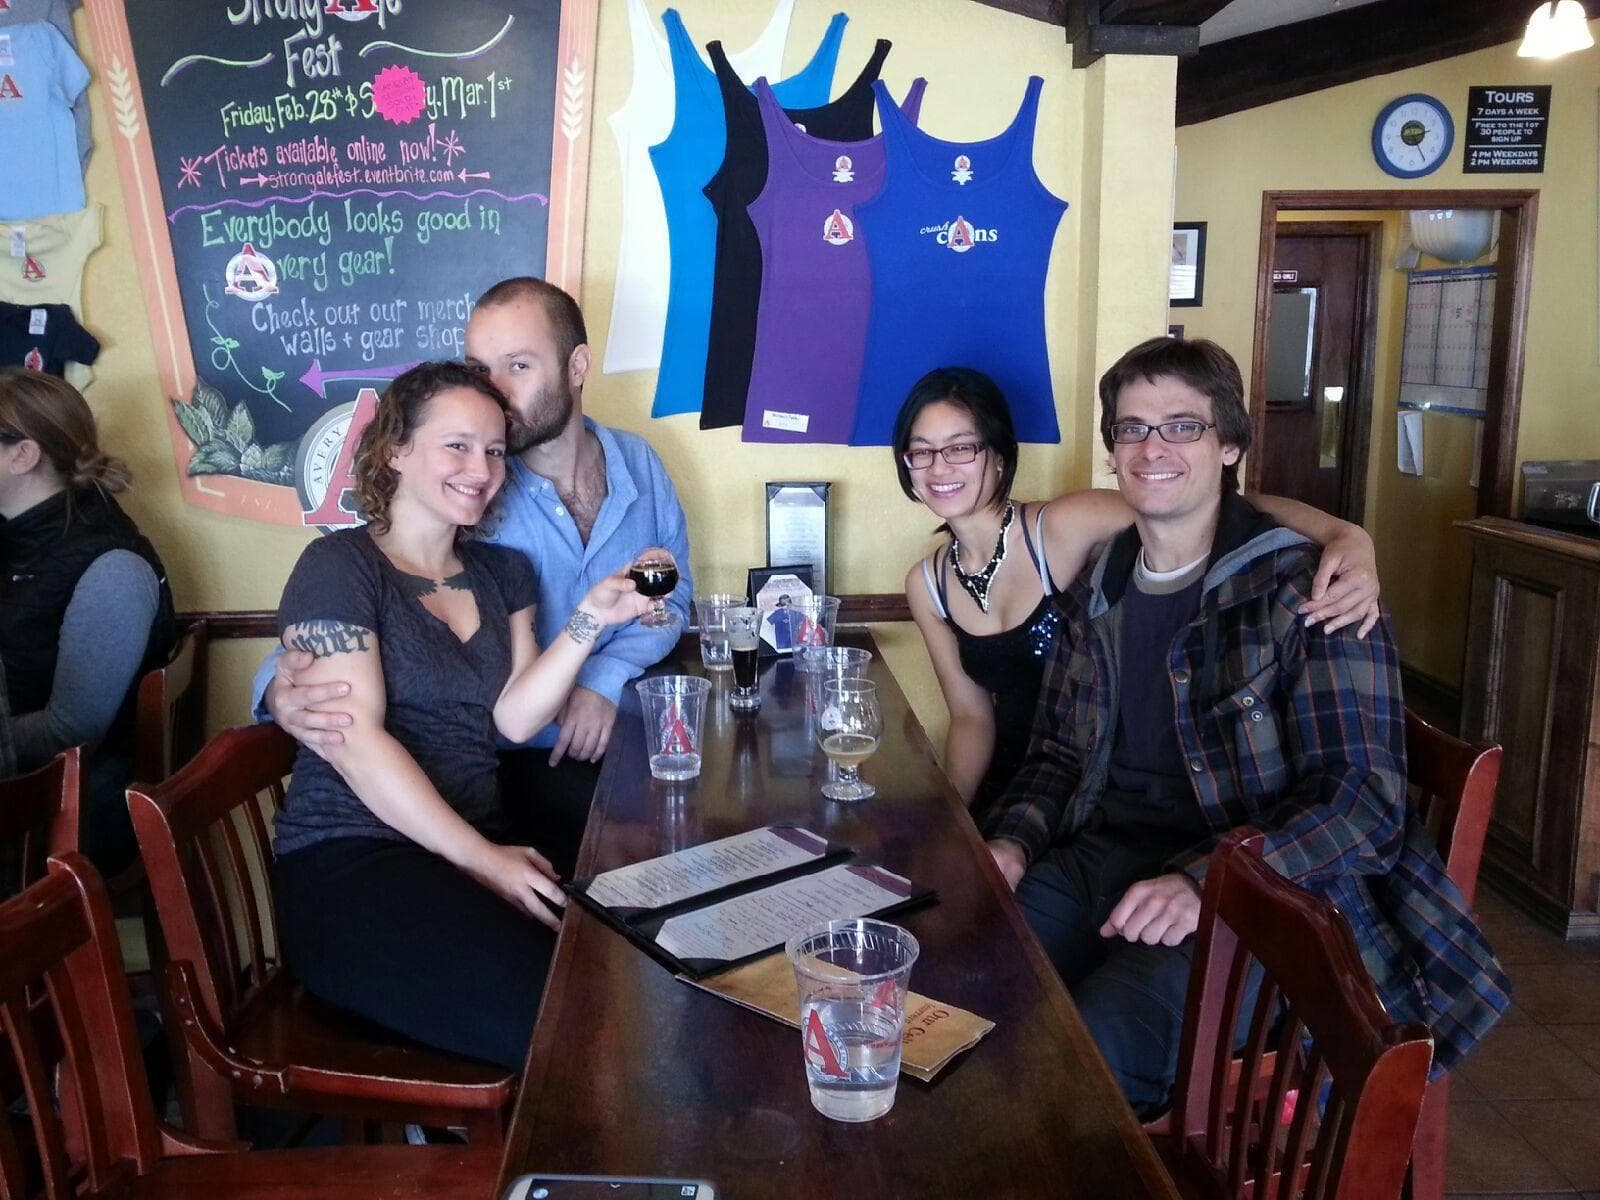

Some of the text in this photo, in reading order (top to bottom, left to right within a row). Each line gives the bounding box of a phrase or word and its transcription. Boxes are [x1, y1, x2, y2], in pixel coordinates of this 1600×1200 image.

[284, 29, 343, 88] Fest
[204, 122, 437, 189] Tickets available online now!
[1470, 158, 1477, 166] 2
[268, 161, 454, 194] strongalefest.eventbrite.com
[201, 198, 501, 249] Everybody looks good in
[920, 221, 950, 235] crush
[338, 236, 395, 286] gear!
[252, 297, 317, 334] Check
[325, 304, 360, 325] out
[370, 299, 407, 322] our
[281, 326, 336, 356] walls
[361, 328, 404, 361] gear
[313, 425, 342, 484] AVERY
